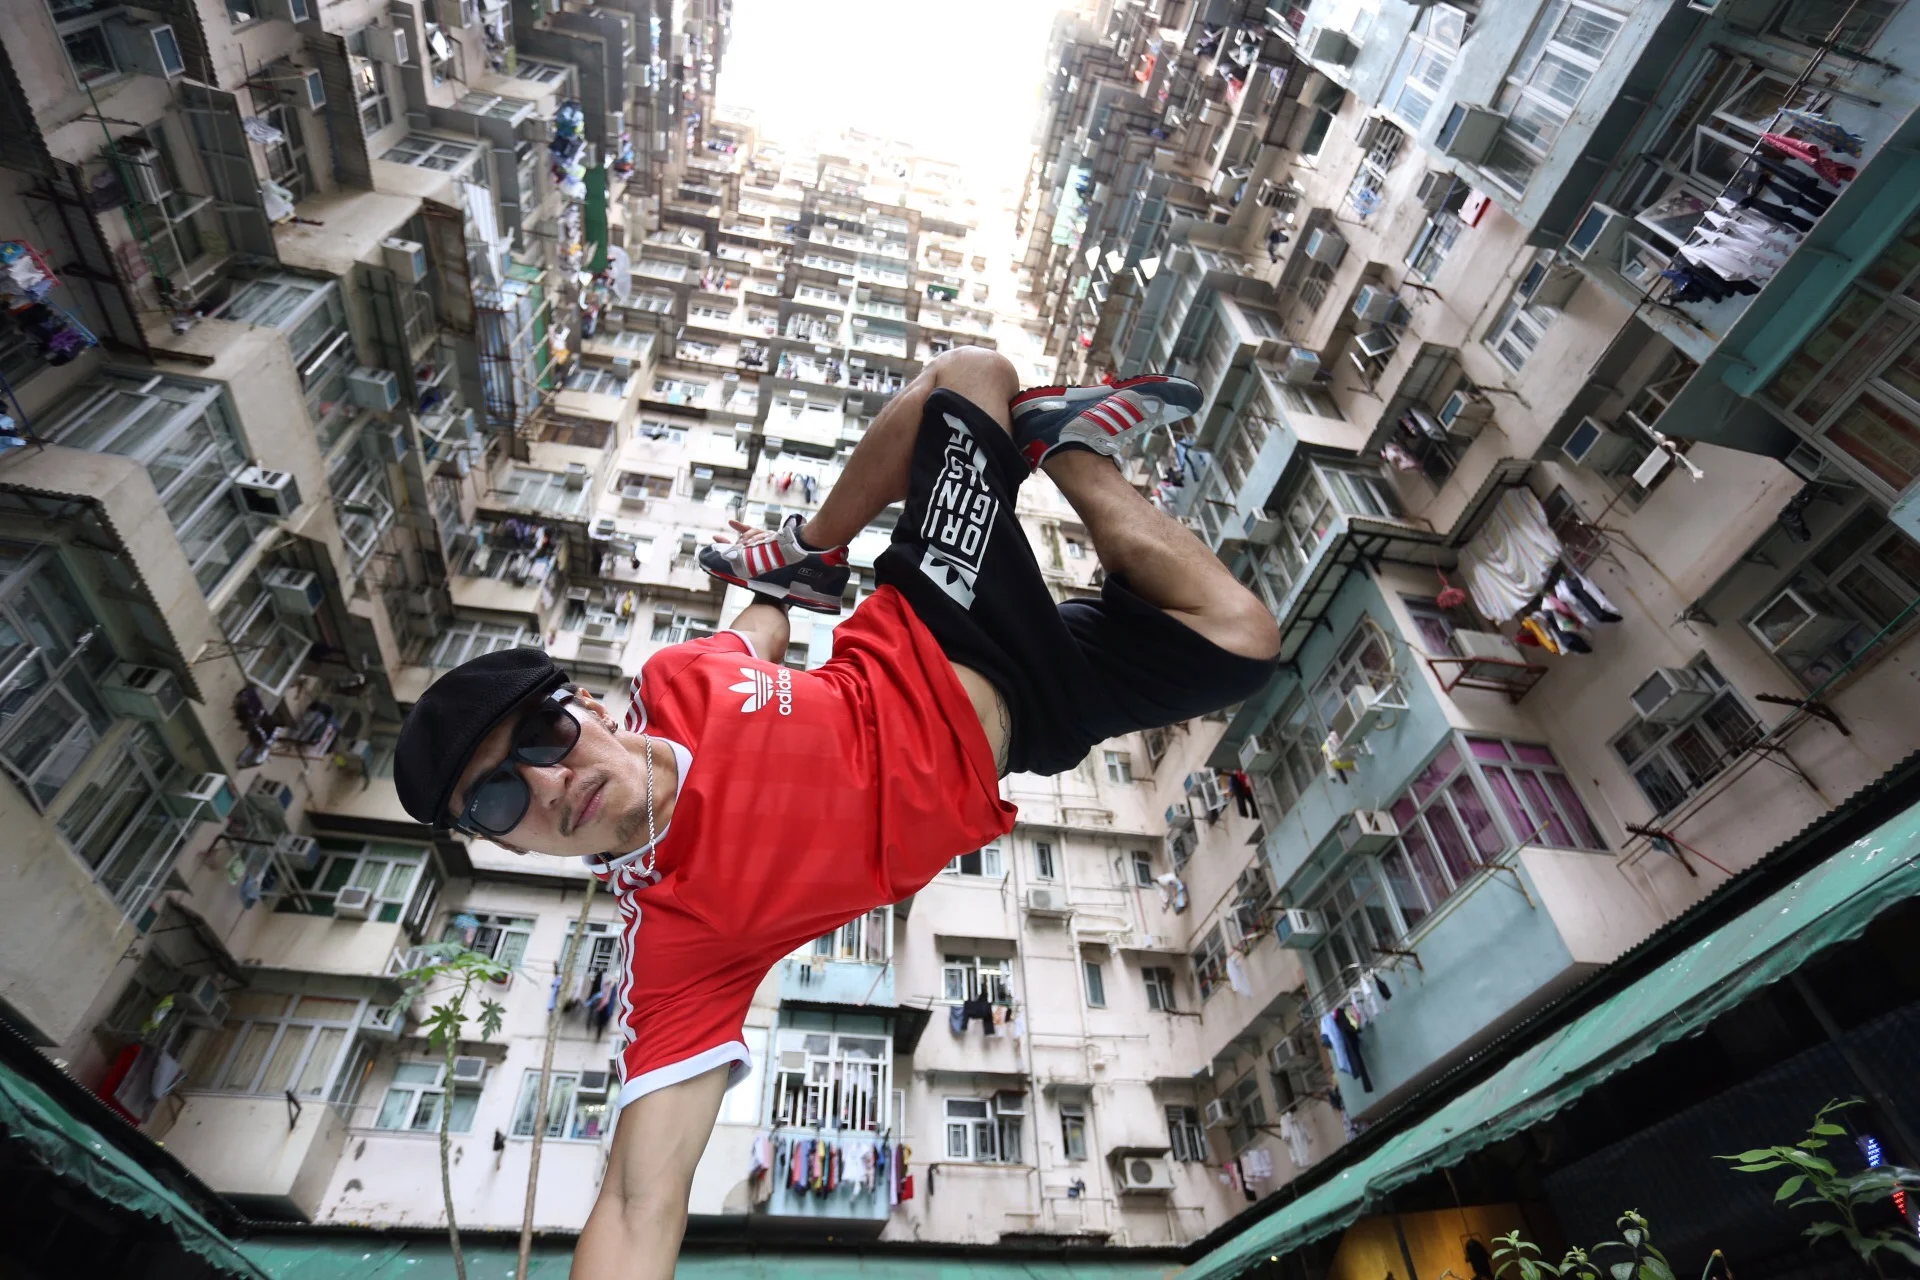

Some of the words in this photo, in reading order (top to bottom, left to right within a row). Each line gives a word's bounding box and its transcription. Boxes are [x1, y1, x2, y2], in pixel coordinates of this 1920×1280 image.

[936, 479, 991, 526] GIN
[927, 508, 982, 557] ORI
[776, 668, 792, 716] adidas
